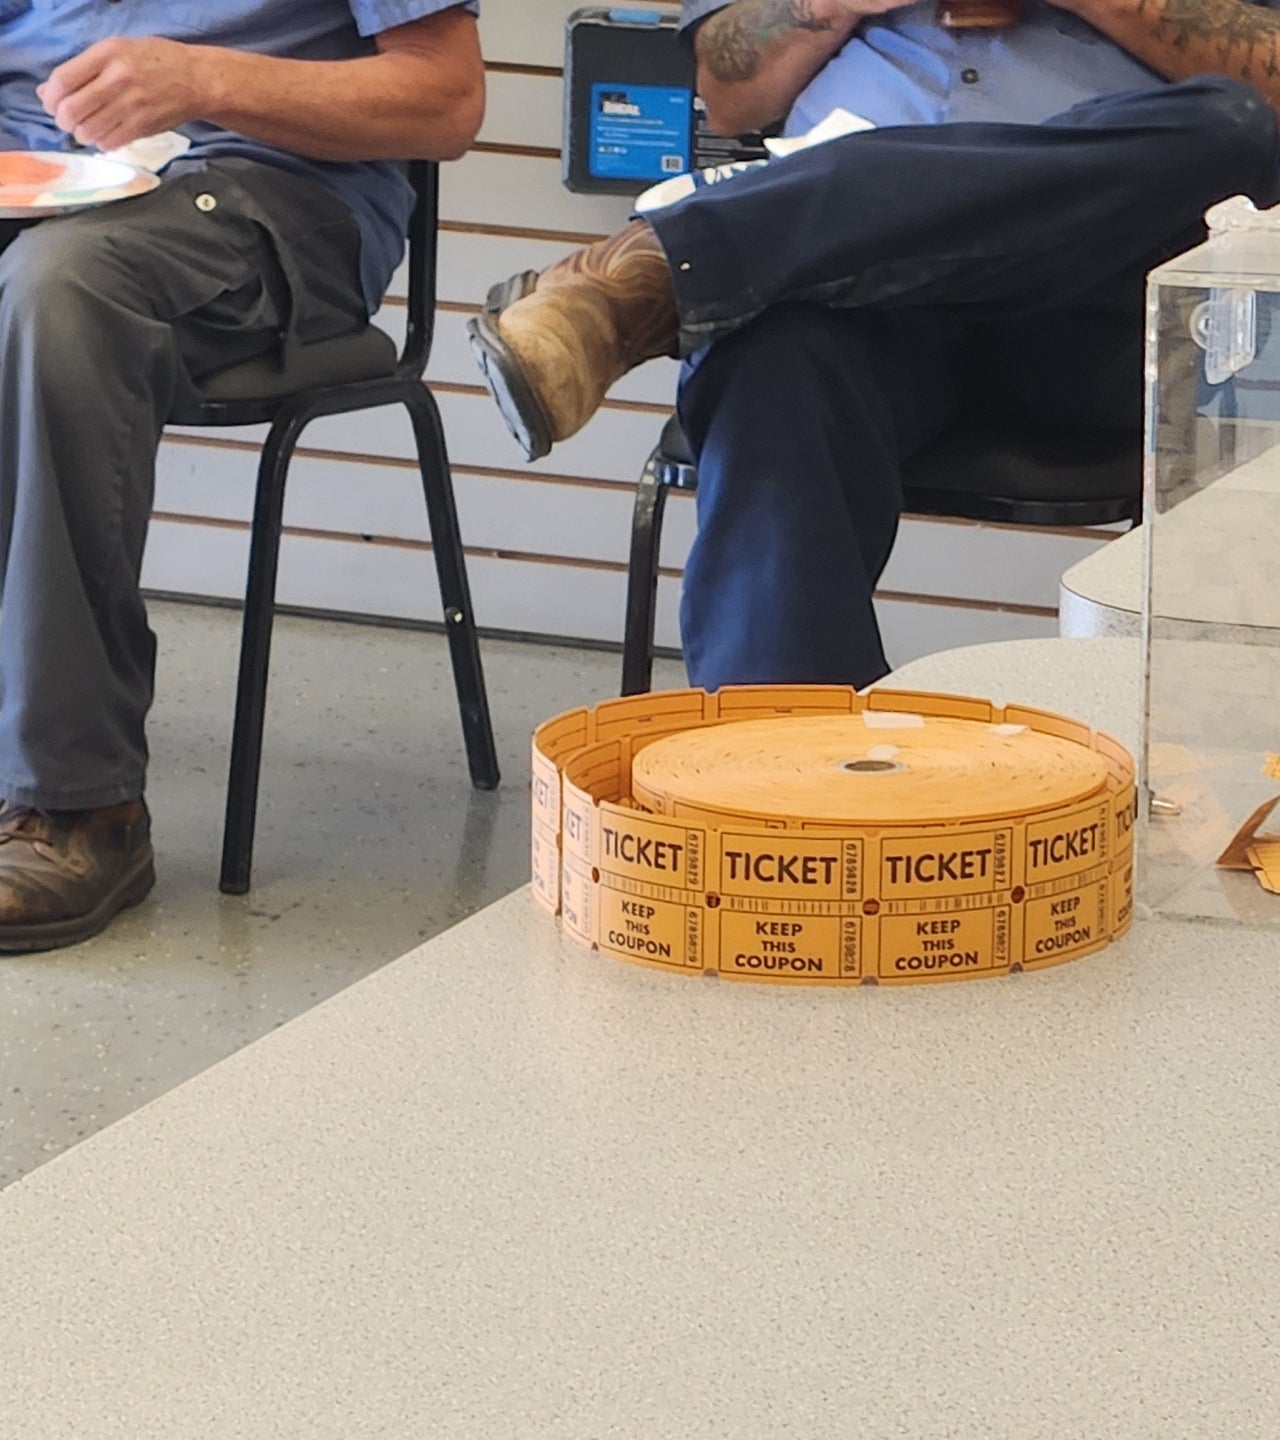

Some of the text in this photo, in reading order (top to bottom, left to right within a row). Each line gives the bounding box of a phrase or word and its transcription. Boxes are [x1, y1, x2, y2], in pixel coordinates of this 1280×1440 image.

[602, 827, 684, 872] TICKET
[1028, 822, 1099, 869] TICKET
[724, 850, 838, 885] TICKET
[884, 848, 993, 885] TICKET
[621, 900, 655, 920] KEEP
[1050, 896, 1081, 917] KEEP
[625, 919, 651, 936] THIS
[756, 921, 803, 937] KEEP
[916, 919, 961, 937] KEEP
[1054, 915, 1077, 932] THIS
[608, 930, 671, 958] COUPON
[761, 940, 797, 953] THIS
[922, 938, 955, 953] THIS
[1035, 925, 1091, 954] COUPON
[735, 953, 823, 972] COUPON
[895, 950, 979, 972] COUPON
